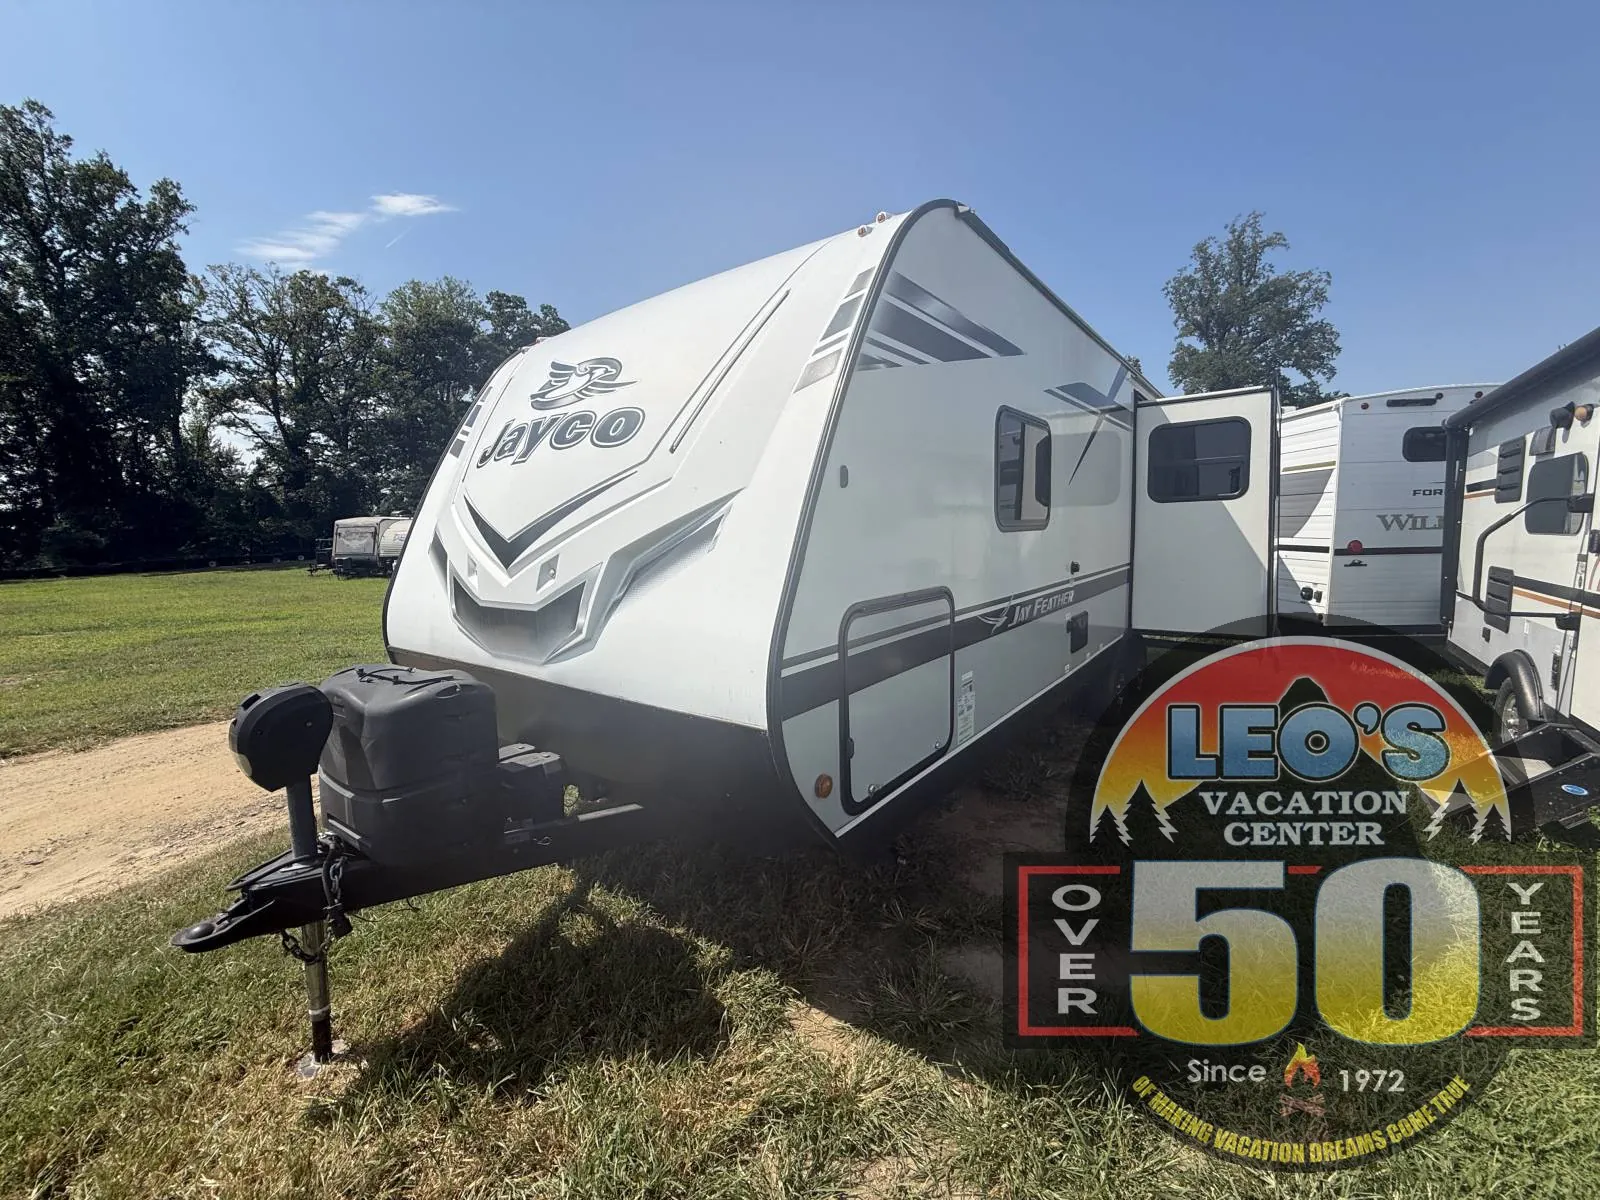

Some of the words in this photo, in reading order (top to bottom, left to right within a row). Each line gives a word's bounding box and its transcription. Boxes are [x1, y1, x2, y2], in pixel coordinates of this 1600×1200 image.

[476, 406, 646, 469] Jayco
[1008, 605, 1033, 628] JAY
[1033, 590, 1075, 617] FEATHER
